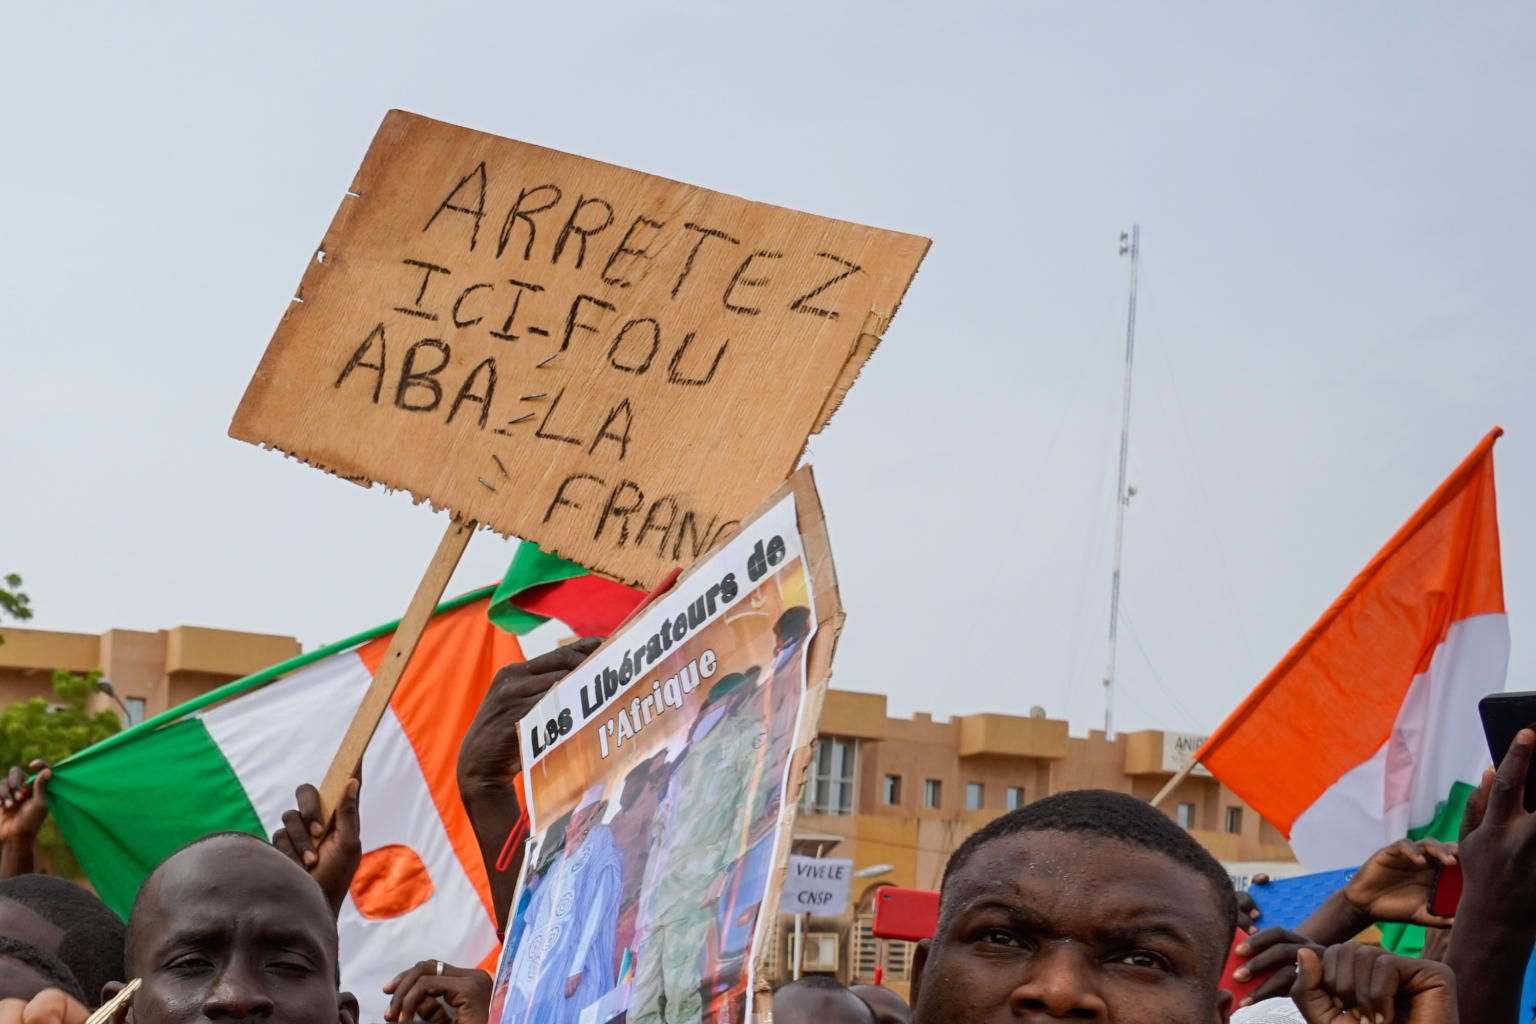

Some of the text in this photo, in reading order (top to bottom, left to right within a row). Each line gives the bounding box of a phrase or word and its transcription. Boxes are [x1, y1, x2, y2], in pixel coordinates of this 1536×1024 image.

[424, 162, 863, 320] ARRETEZ
[531, 534, 786, 759] Les Libérateurs de
[598, 649, 717, 759] l'Afrique
[796, 863, 844, 880] VIVE LE
[797, 890, 832, 905] CNSP
